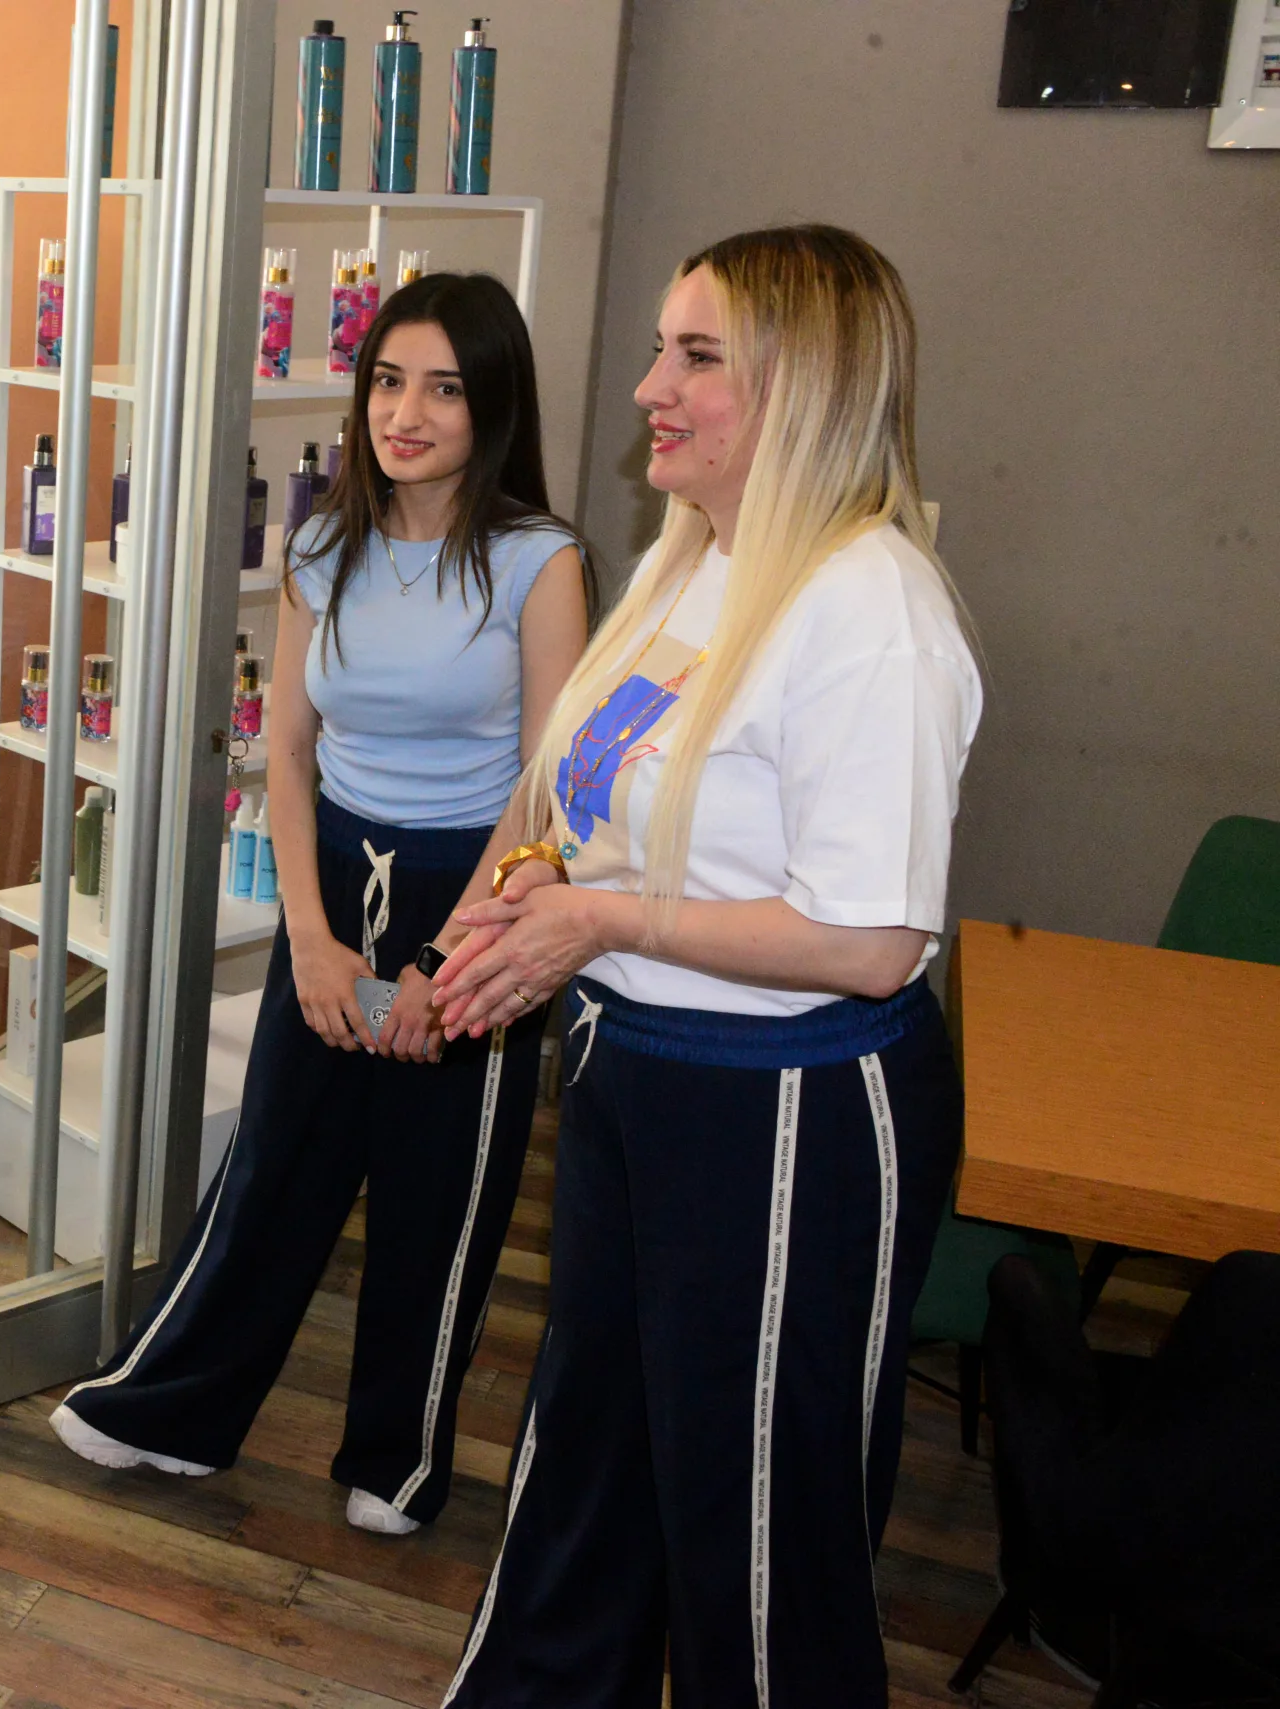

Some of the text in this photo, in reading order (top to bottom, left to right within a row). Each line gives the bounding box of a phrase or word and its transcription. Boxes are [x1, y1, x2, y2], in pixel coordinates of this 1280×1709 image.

[785, 1082, 794, 1104] VINTAGE
[869, 1070, 880, 1094] VINTAGE
[783, 1105, 792, 1130] NATURAL
[874, 1094, 884, 1120] NATURAL
[779, 1135, 790, 1183] VINTAGE NATURAL
[881, 1123, 892, 1171] VINTAGE NATURAL
[775, 1189, 785, 1236] VINTAGE NATURAL
[771, 1242, 782, 1289] VINTAGE NATURAL
[766, 1294, 777, 1337] VINTAGE NATURAL
[762, 1342, 772, 1383] VINTAGE NATURAL
[759, 1387, 768, 1430] VINTAGE NATURAL
